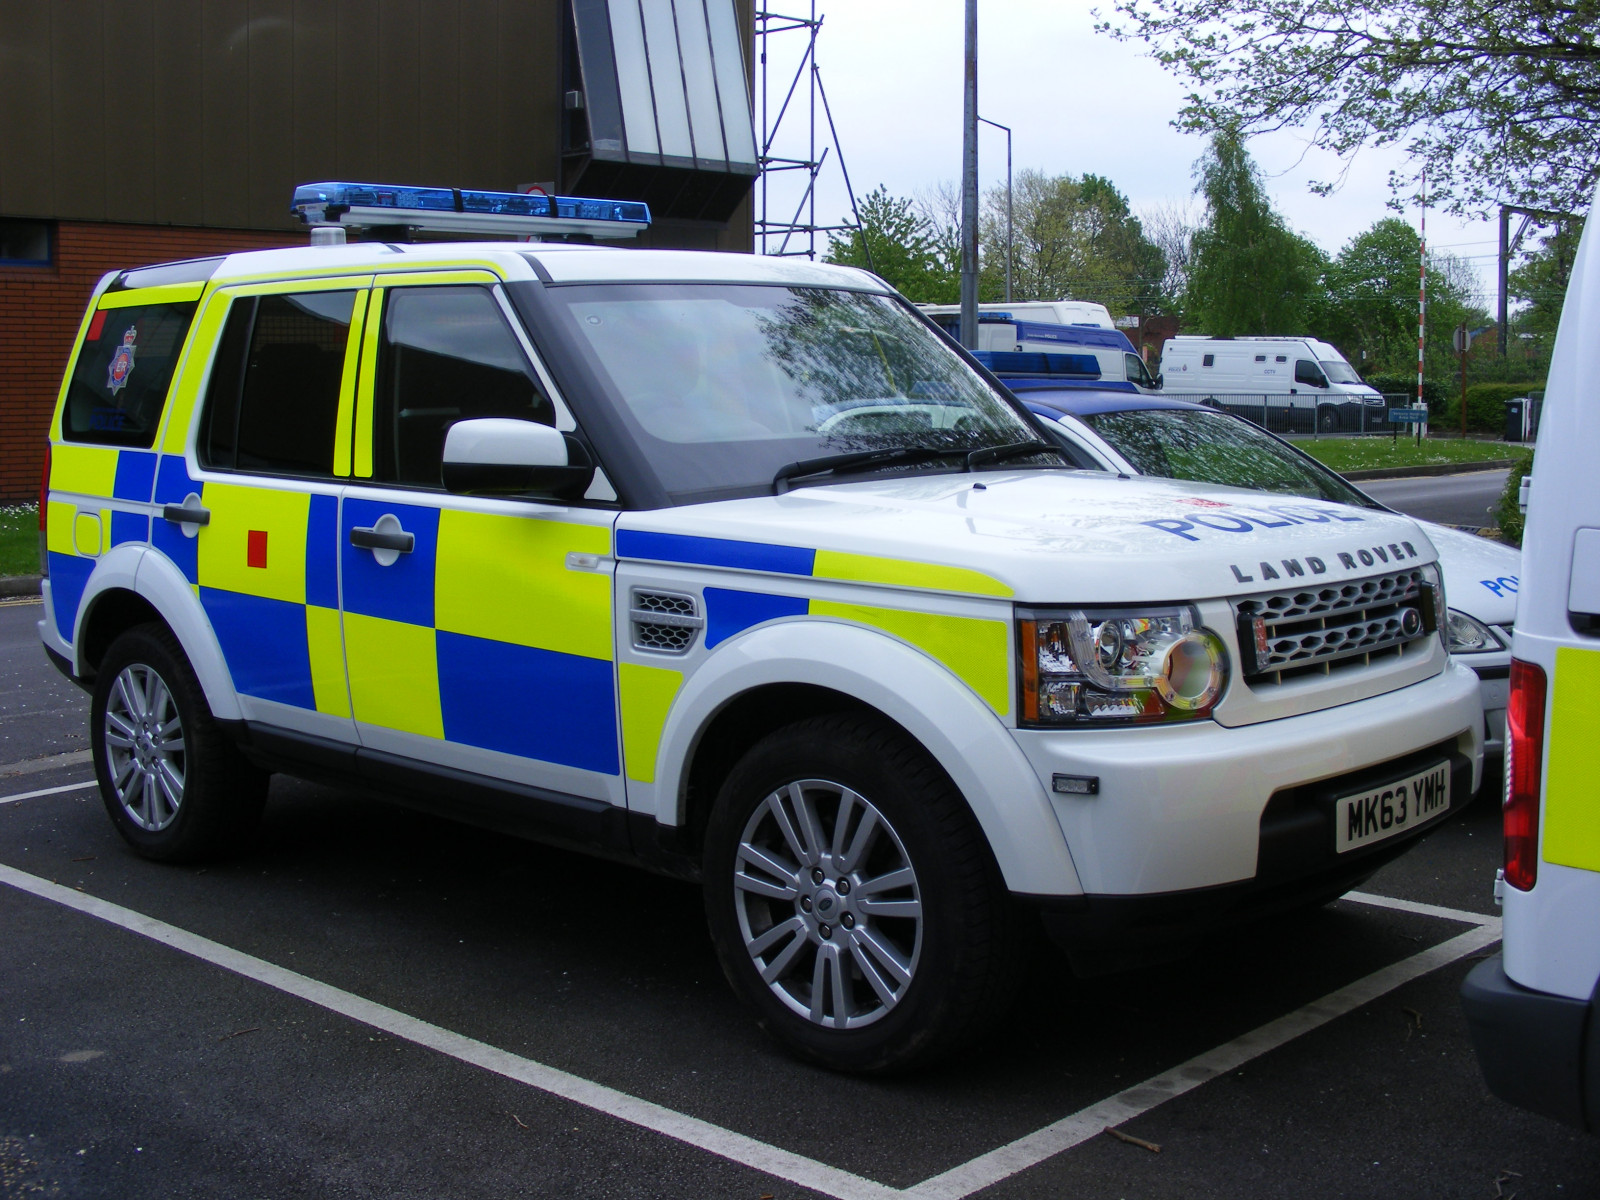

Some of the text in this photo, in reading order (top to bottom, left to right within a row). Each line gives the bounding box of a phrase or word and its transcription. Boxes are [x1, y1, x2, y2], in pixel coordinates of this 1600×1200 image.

[1140, 504, 1365, 541] POLICE
[1230, 541, 1418, 582] LAND ROVER
[1348, 769, 1446, 841] MK63 YMH
